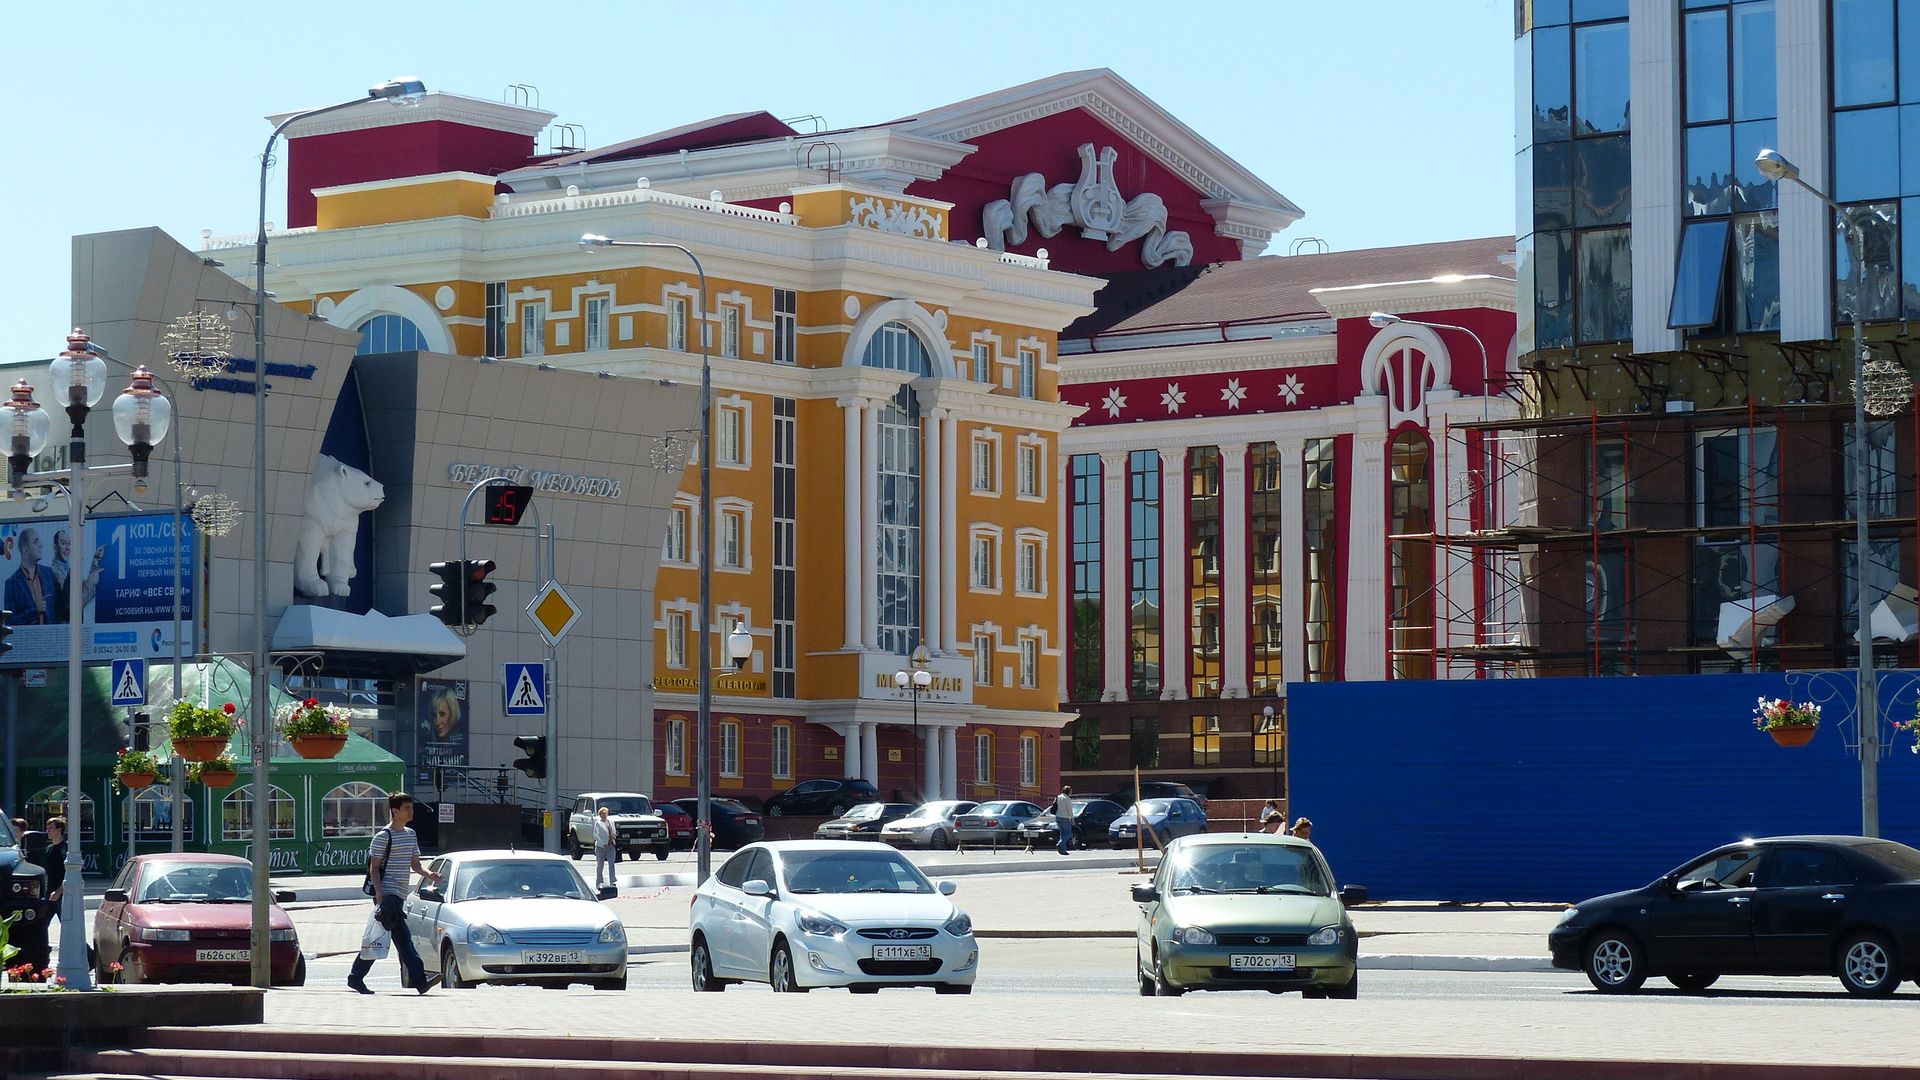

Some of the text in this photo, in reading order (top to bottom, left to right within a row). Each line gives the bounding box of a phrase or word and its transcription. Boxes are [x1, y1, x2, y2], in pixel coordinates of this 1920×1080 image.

[451, 463, 622, 498] БЕЛЫЙ МЕДВЕДЬ
[111, 524, 127, 580] 1
[129, 556, 191, 567] МОБИЛЬНЫЕ ПСЛЕ
[138, 567, 162, 577] ПЕРВОЙ
[115, 588, 142, 598] ТАРИФ
[164, 586, 191, 596] СВИ»
[115, 606, 144, 616] УСЛОВИЯ
[144, 606, 154, 615] НА
[655, 676, 700, 688] РЕСТОРАН
[877, 673, 963, 692] МЕИИАН
[314, 841, 371, 867] свежес
[200, 950, 237, 960] В626СК
[877, 947, 916, 957] Е111ХЕ
[529, 953, 567, 963] К392ВЕ
[1234, 956, 1278, 967] Е702СУ
